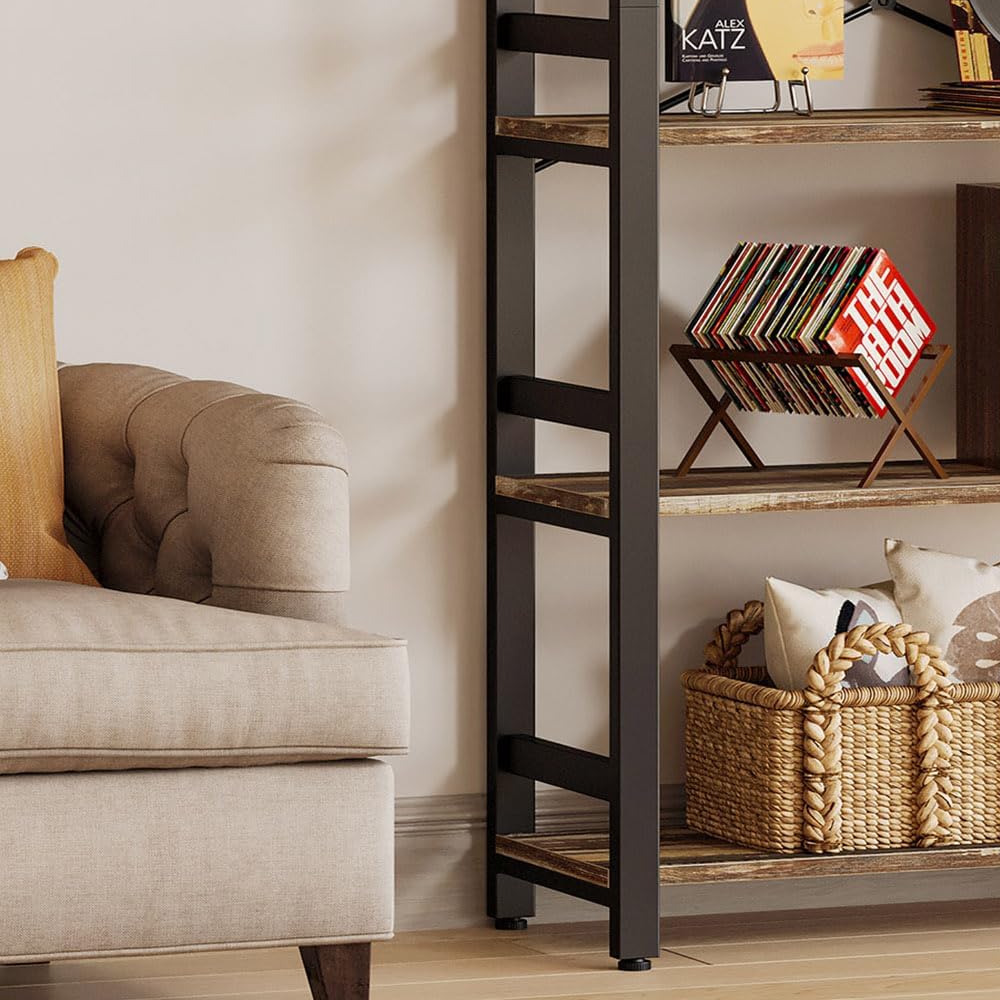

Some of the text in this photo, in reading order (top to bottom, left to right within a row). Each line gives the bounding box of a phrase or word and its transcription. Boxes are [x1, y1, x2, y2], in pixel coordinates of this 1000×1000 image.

[714, 19, 745, 28] ALEX
[681, 28, 746, 50] KATZ
[843, 254, 897, 334] THE
